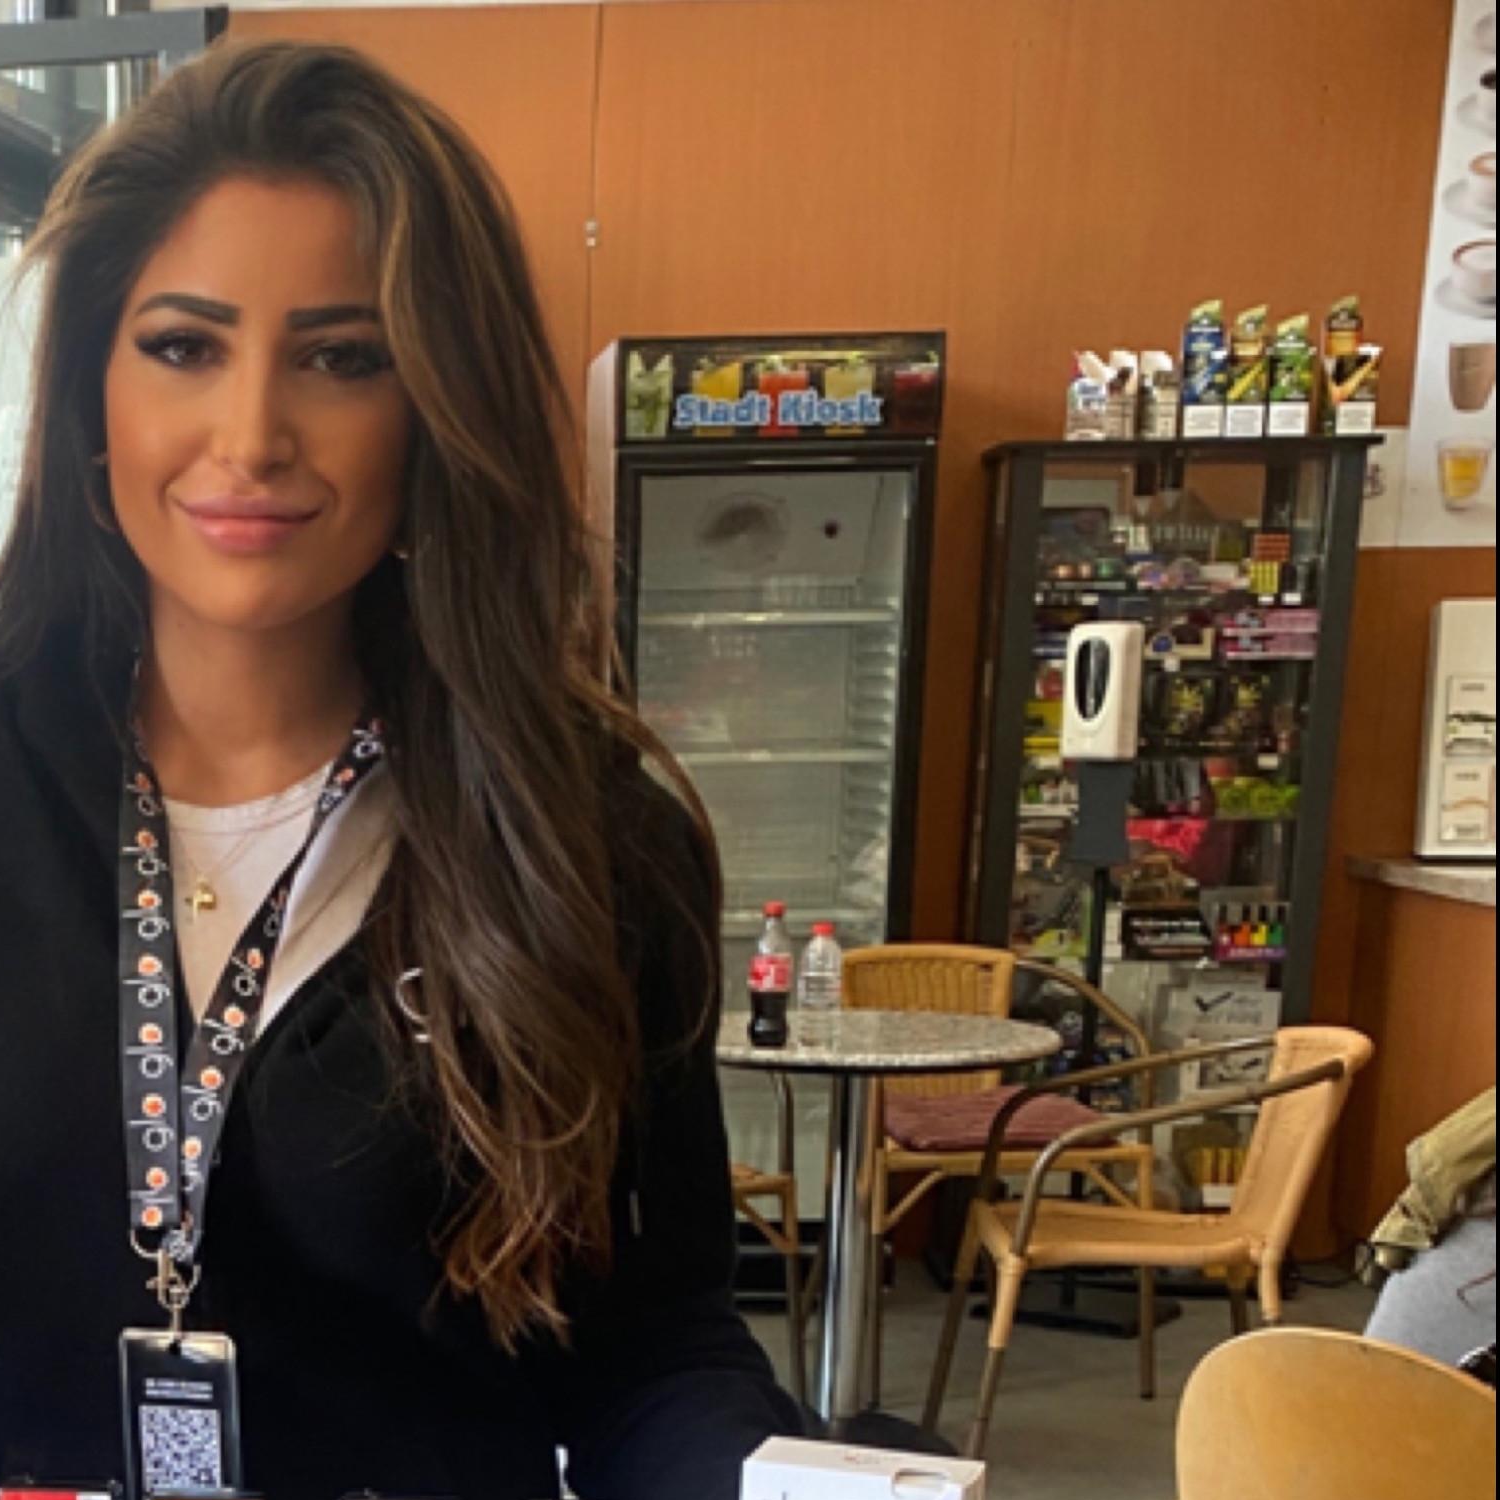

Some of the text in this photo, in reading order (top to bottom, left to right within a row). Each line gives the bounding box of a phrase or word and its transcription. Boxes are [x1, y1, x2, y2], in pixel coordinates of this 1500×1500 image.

[673, 387, 887, 427] Stadt Kiosk
[122, 955, 171, 1008] glo
[125, 1022, 174, 1079] glo
[203, 1004, 246, 1055] glo
[181, 1066, 223, 1121] glo
[127, 1093, 175, 1152] glo
